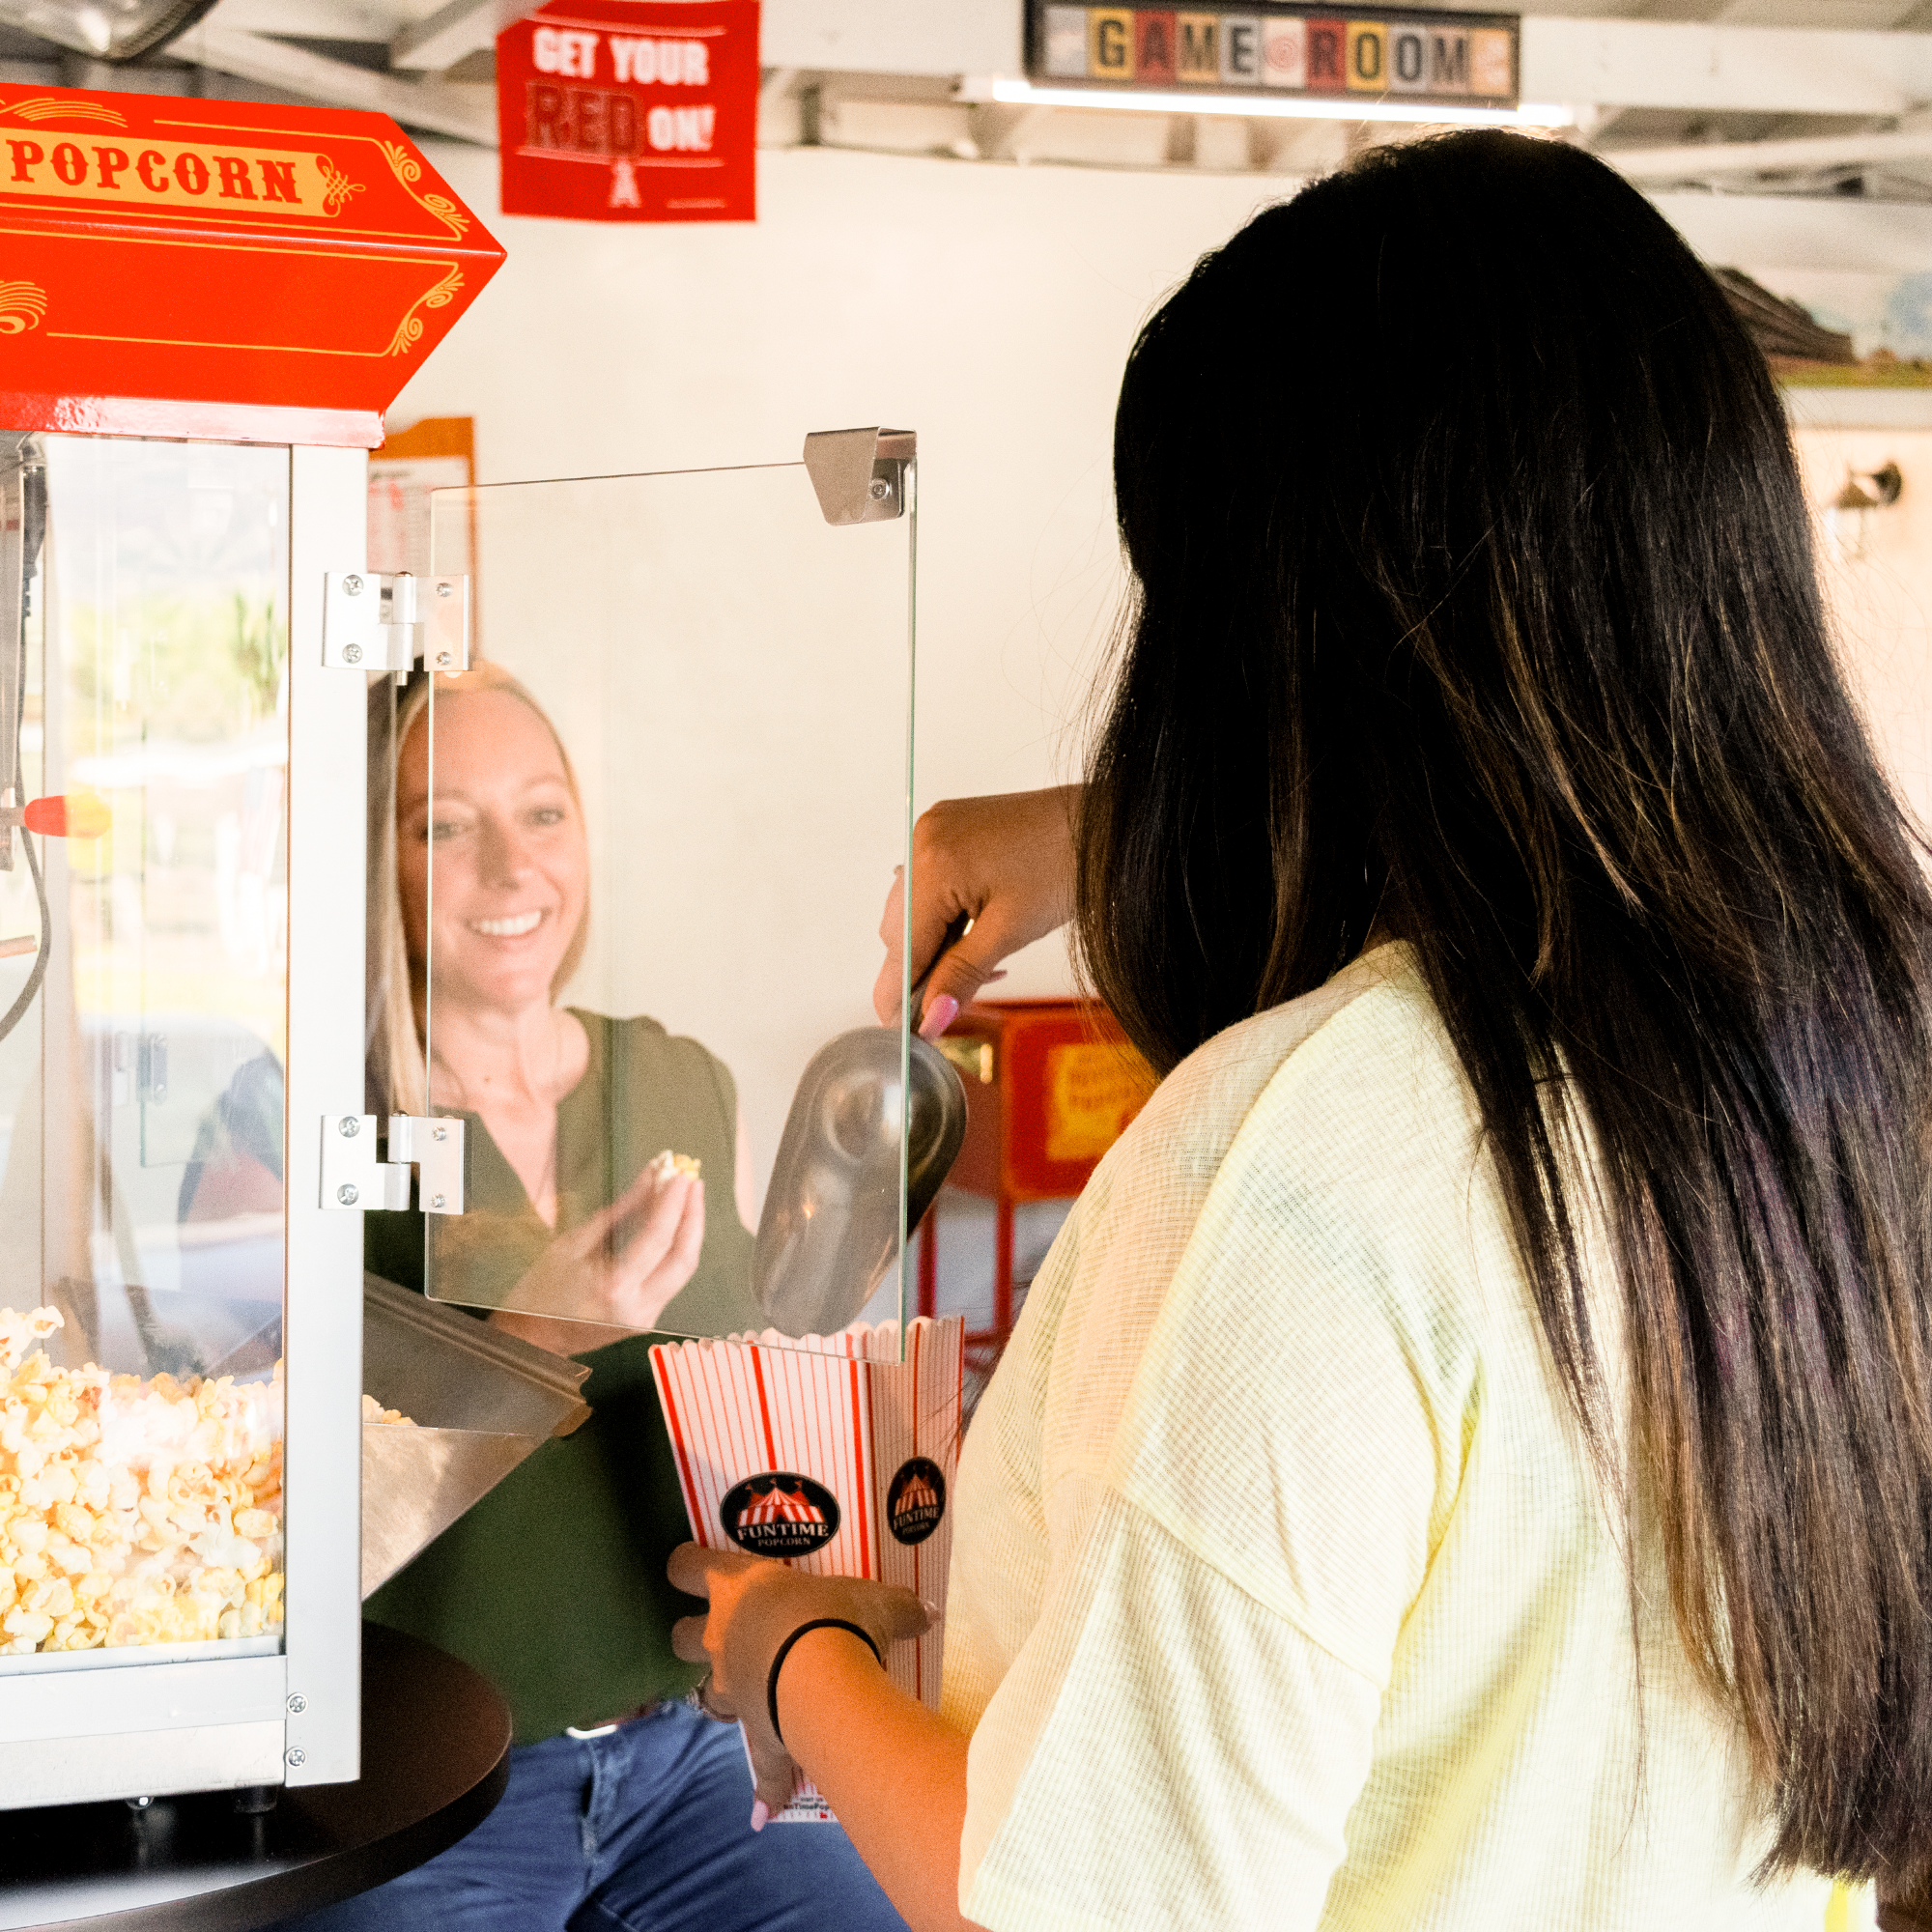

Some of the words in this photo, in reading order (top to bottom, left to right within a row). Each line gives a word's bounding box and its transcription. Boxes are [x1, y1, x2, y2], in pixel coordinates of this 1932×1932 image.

[532, 26, 600, 79] GET
[609, 36, 711, 86] YOUR
[1097, 18, 1253, 74] GAME
[1310, 28, 1466, 83] ROOM
[527, 80, 639, 154] RED
[5, 139, 302, 204] POPCORN
[737, 1523, 829, 1541] FUNTIME
[757, 1537, 811, 1547] POPCORN
[894, 1506, 940, 1531] FUNTIME
